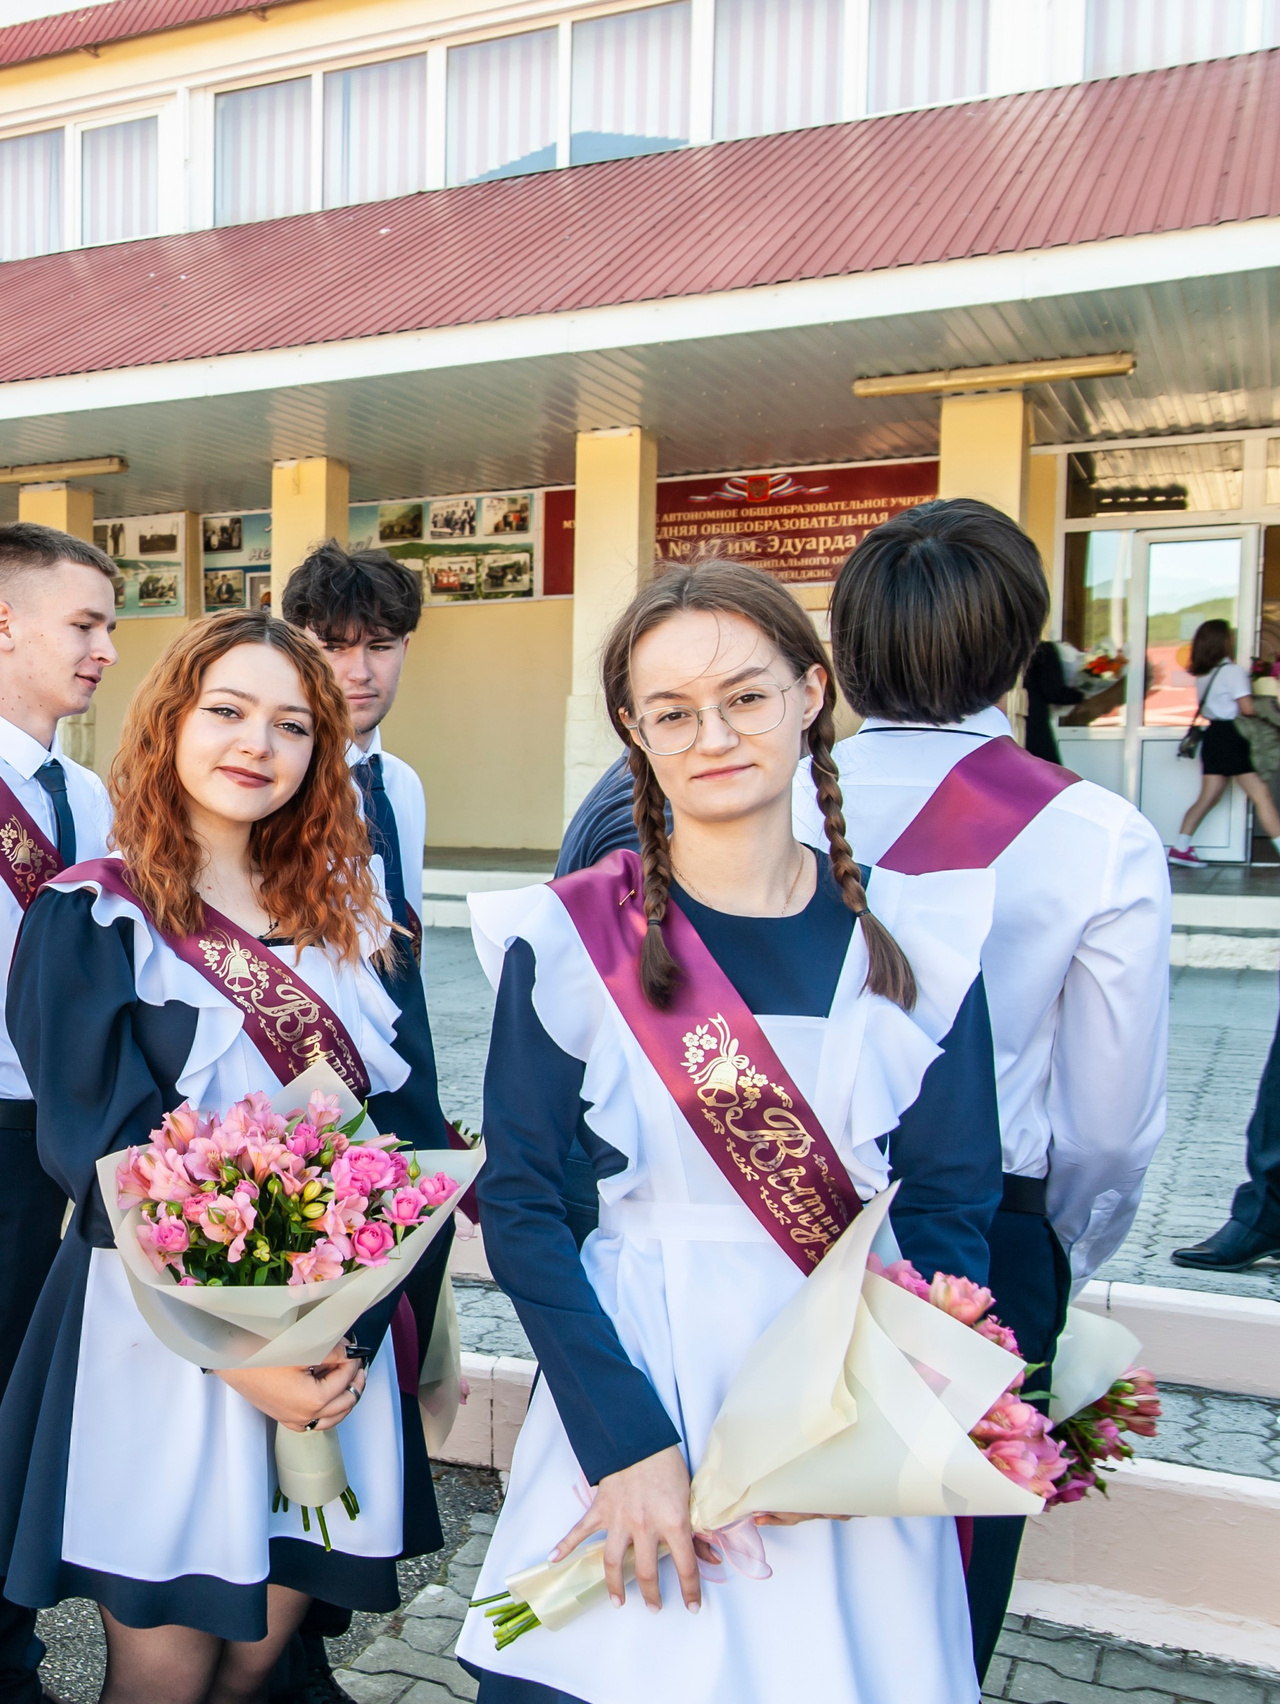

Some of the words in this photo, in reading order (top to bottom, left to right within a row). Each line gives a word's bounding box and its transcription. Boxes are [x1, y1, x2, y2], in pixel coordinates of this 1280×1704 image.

[661, 508, 738, 523] АВТОНОМНОЕ
[741, 499, 888, 517] ОБЩЕОБРАЗОВАТЕЛЬНОЕ
[890, 494, 934, 508] УЧРЕЖ
[700, 511, 889, 535] ОБЩЕОБРАЗОВАТЕЛЬНАЯ
[698, 539, 722, 556] 17
[728, 540, 762, 555] им.
[766, 534, 857, 556] Эдуарда
